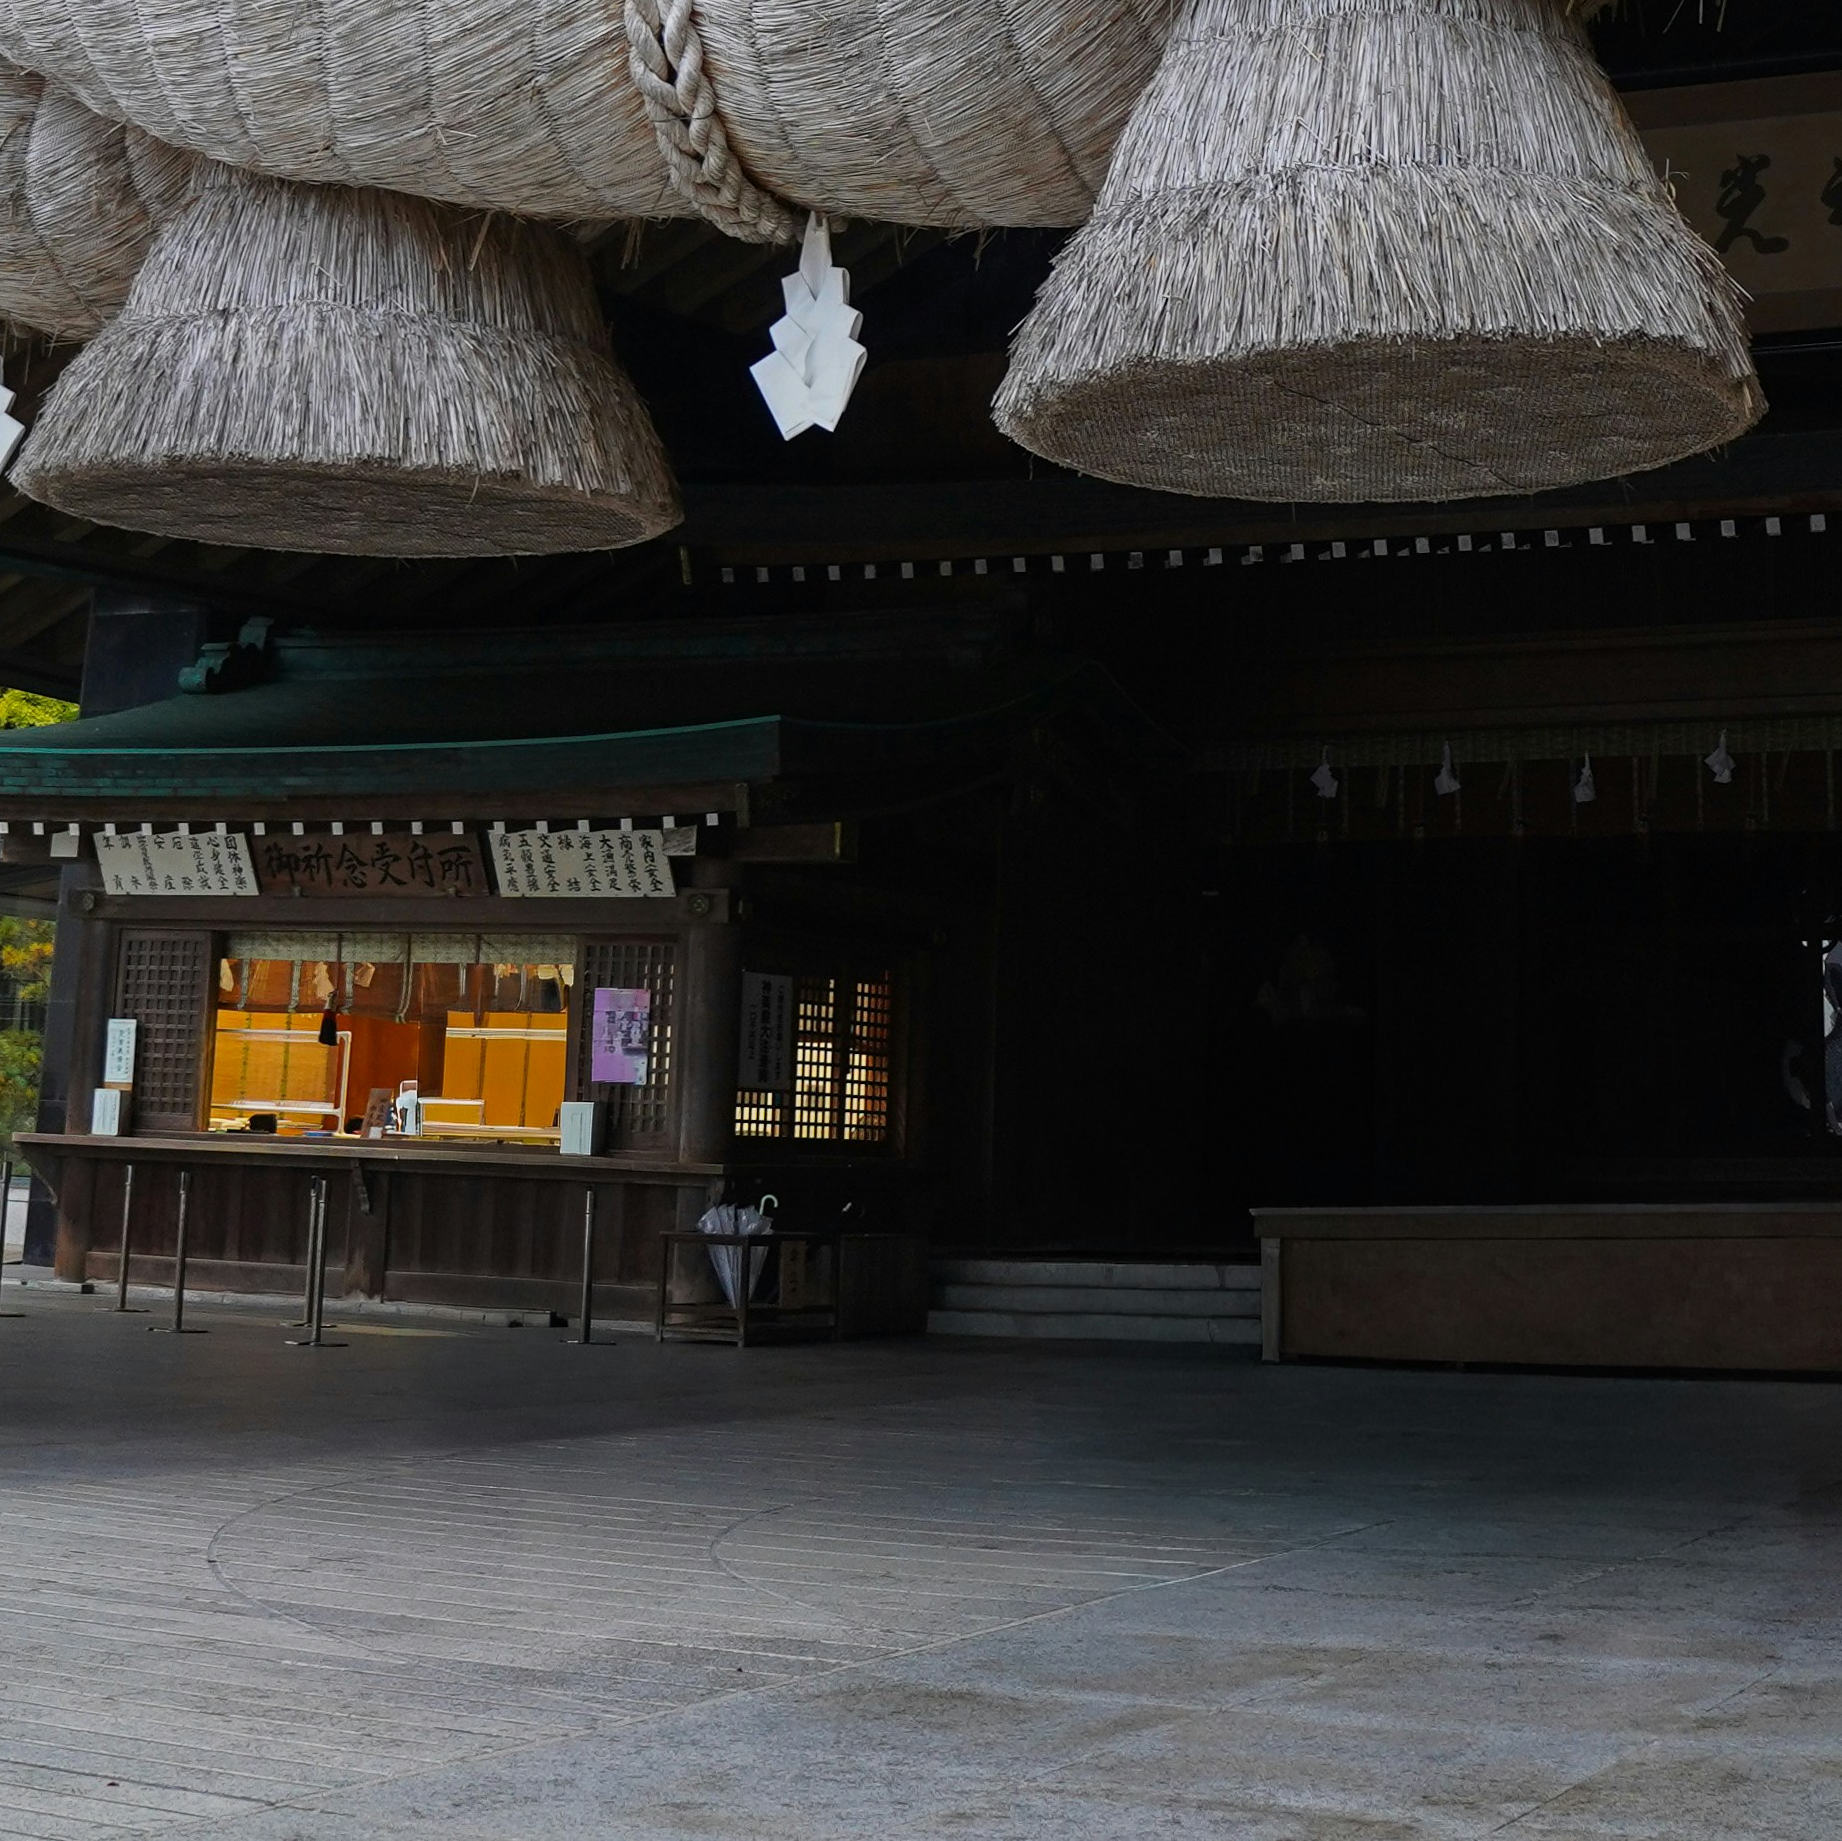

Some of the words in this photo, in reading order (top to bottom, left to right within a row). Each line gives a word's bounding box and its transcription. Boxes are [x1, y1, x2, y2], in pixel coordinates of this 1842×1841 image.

[264, 840, 474, 889] 御祈念受付所
[537, 833, 561, 892] 交通安全
[556, 834, 581, 892] 縁結
[578, 834, 601, 892] 海上安全
[598, 834, 622, 891] 大漁満足
[638, 834, 664, 892] 家内安全
